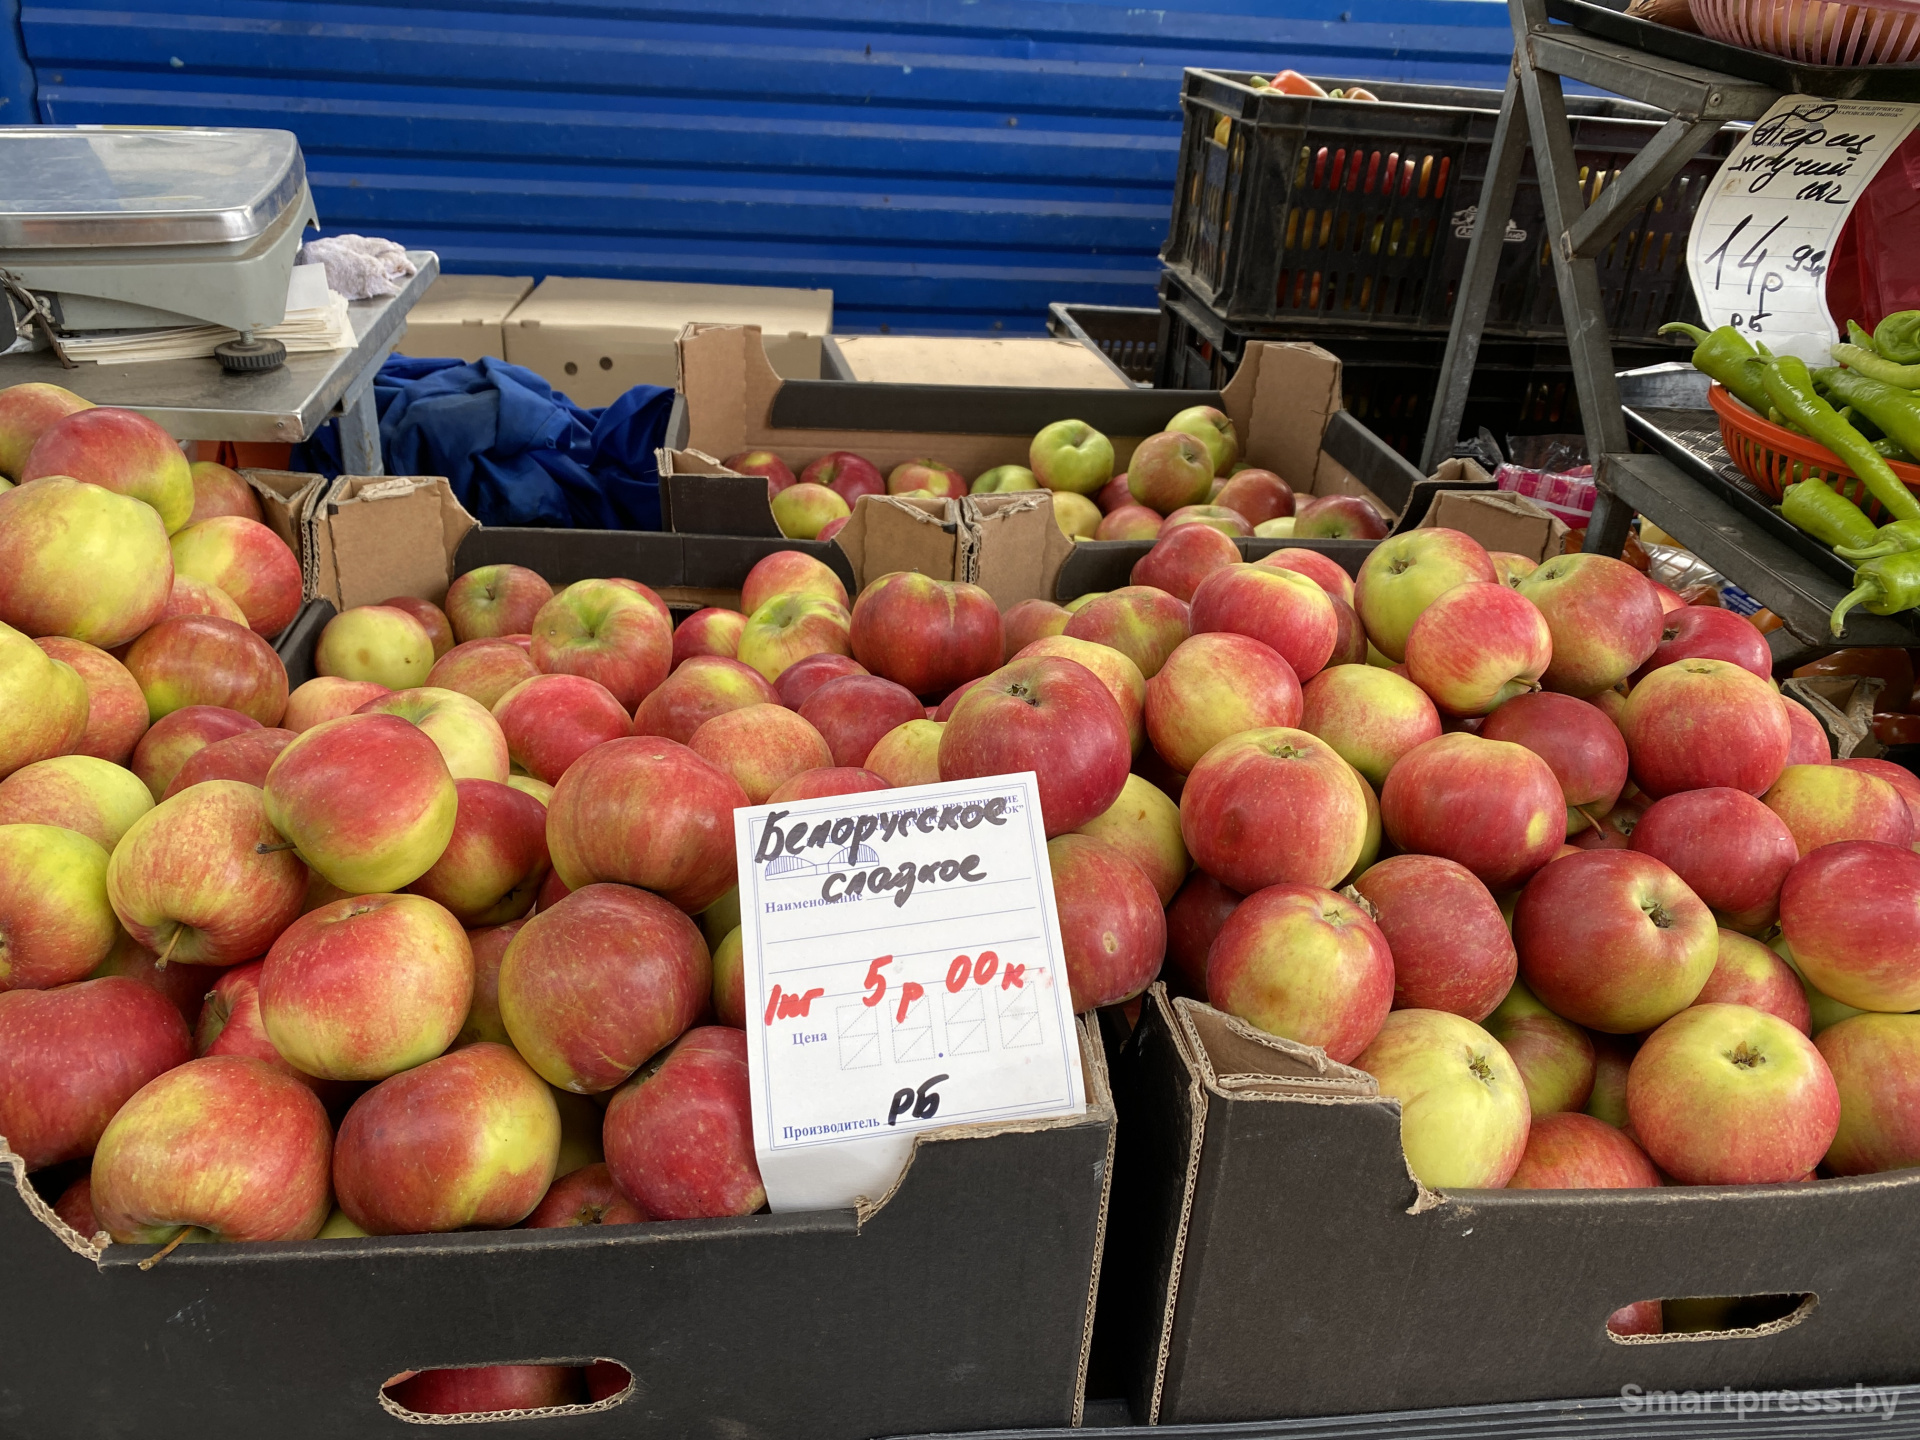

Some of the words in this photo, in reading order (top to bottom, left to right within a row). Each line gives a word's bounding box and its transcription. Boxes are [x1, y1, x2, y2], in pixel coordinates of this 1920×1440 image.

[1826, 109, 1874, 117] КМАРОВСКИЙ
[765, 892, 863, 914] Наименоние
[792, 1031, 828, 1046] Цена
[782, 1117, 881, 1140] Производитель
